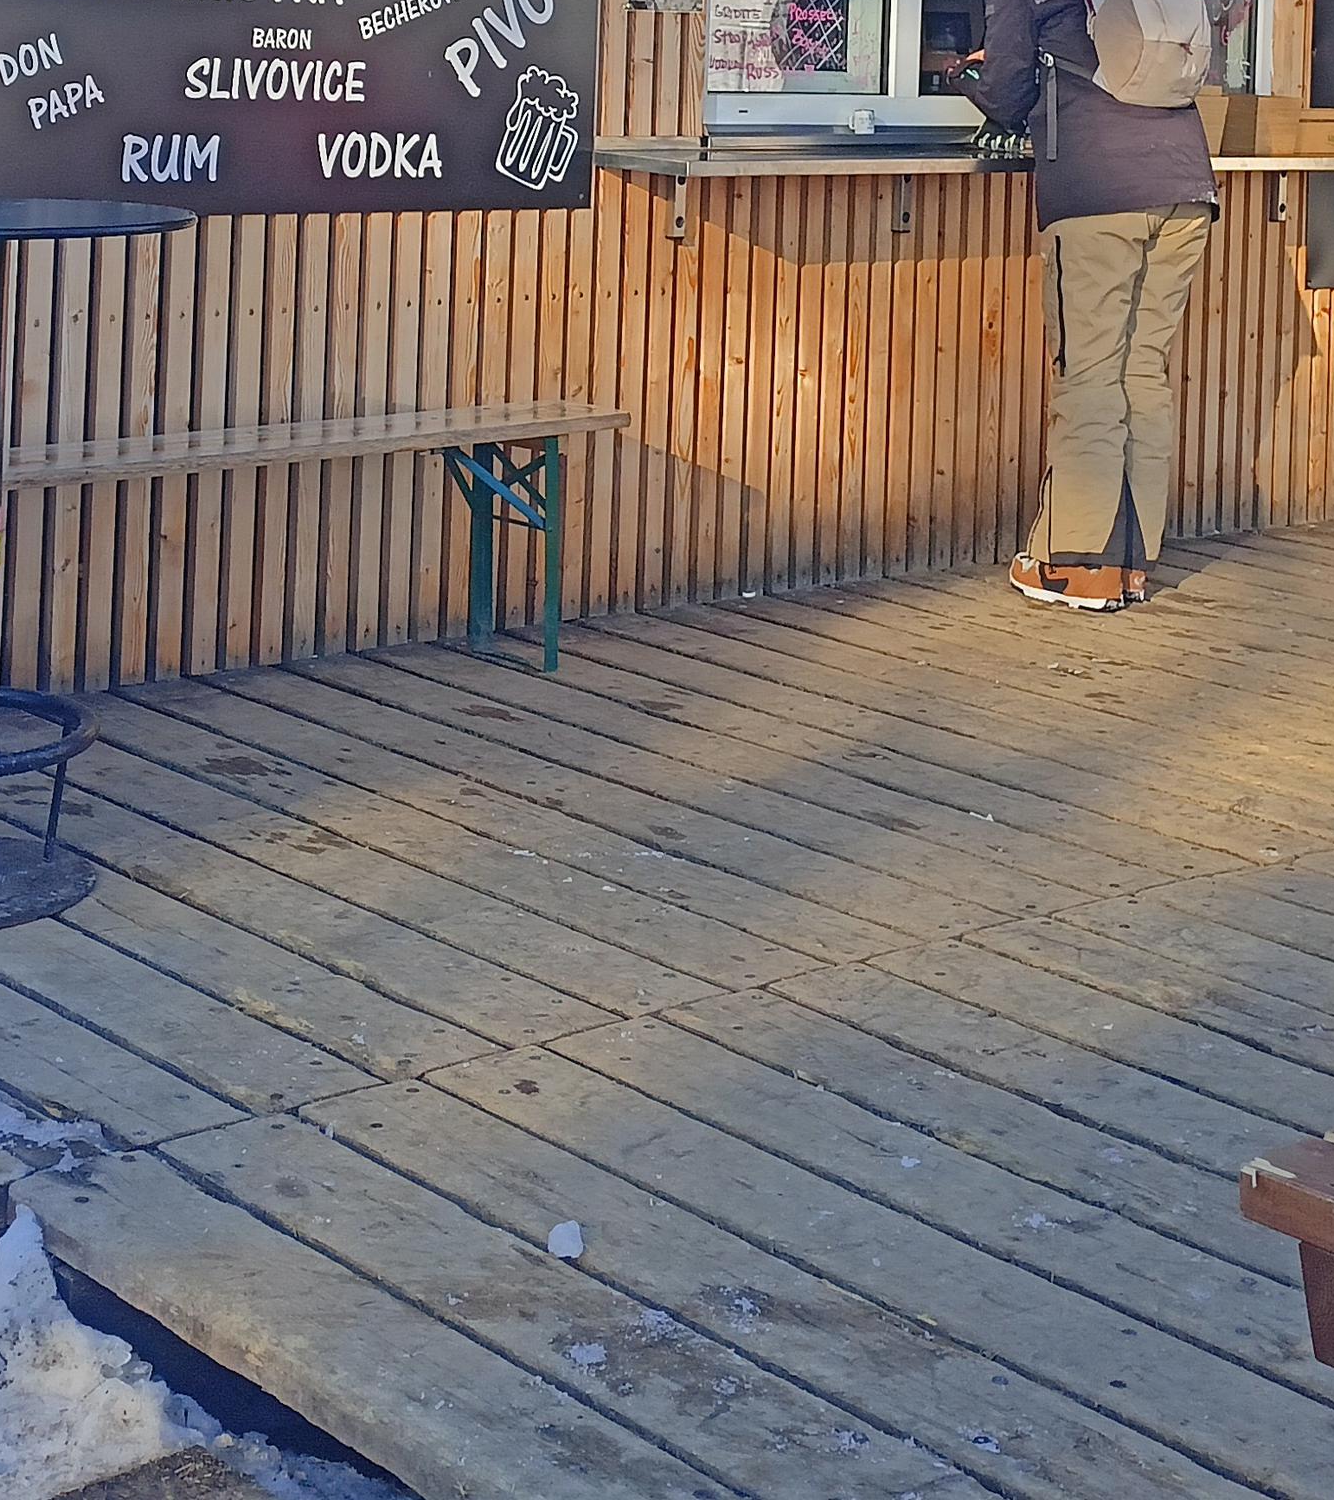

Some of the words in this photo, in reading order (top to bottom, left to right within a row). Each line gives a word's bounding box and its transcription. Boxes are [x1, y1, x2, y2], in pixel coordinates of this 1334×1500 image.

[252, 28, 311, 50] BARON
[27, 74, 105, 129] PAPA
[185, 58, 366, 102] SLIVOVICE
[121, 135, 220, 182] RUM
[317, 133, 442, 178] VODKA
